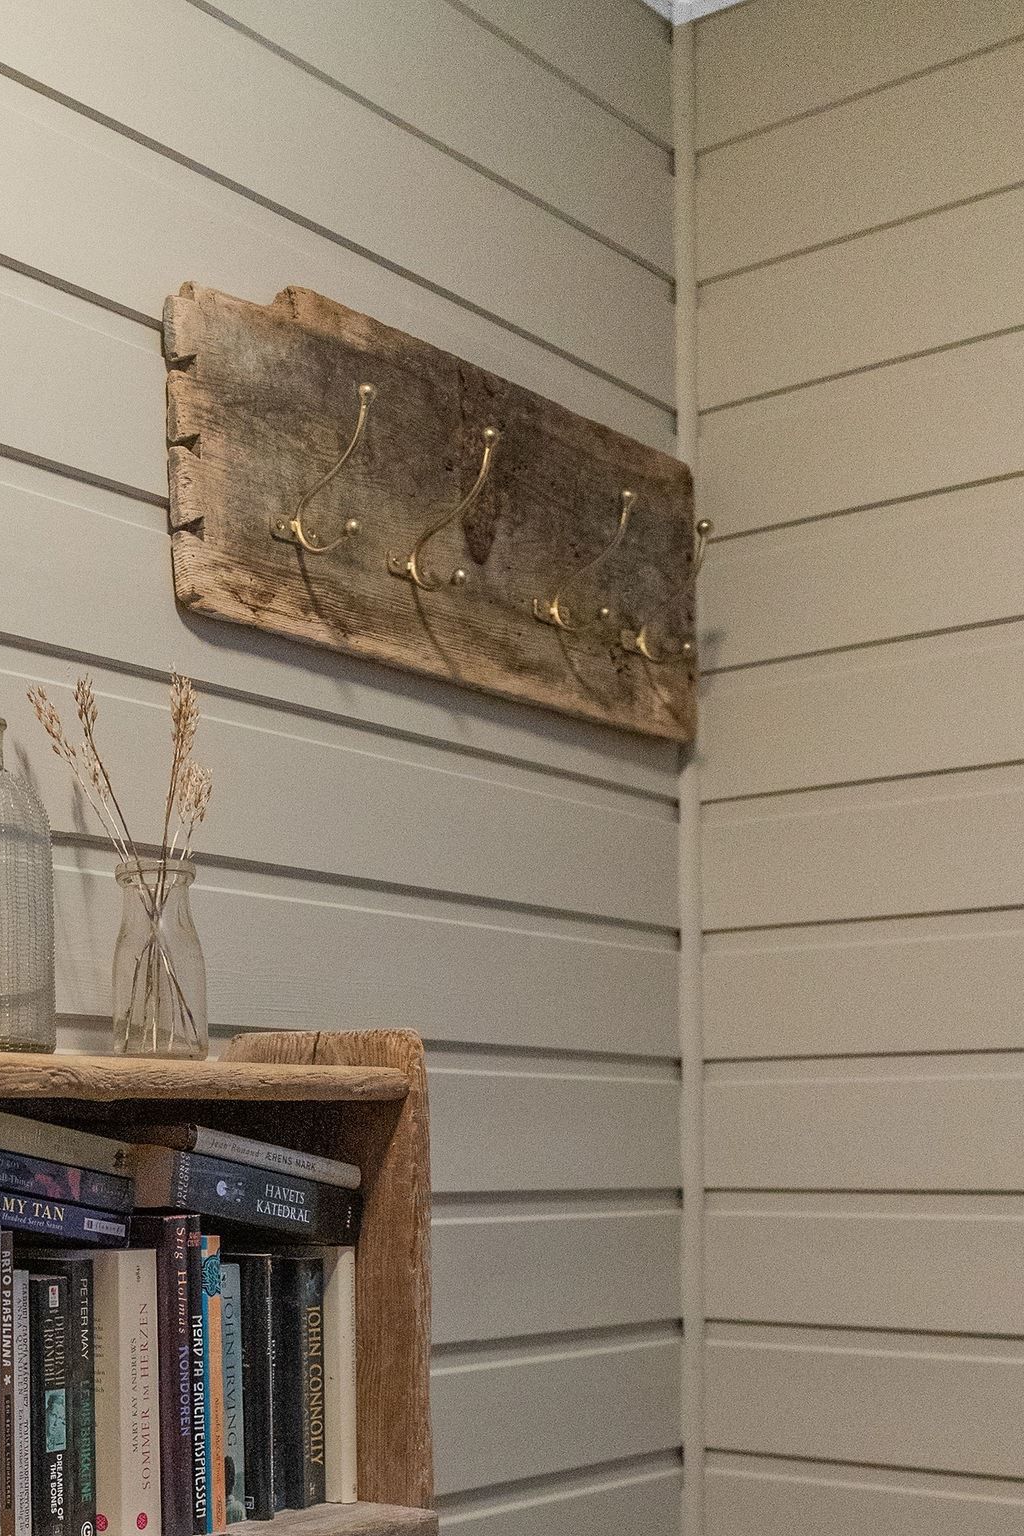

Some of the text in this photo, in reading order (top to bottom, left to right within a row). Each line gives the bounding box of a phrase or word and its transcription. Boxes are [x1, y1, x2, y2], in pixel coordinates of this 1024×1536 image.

[265, 1184, 305, 1205] HAVETS
[295, 1158, 316, 1171] MARK
[32, 1202, 65, 1222] TAN
[174, 1226, 187, 1260] Stig
[256, 1199, 310, 1224] KATEDRAL
[2, 1250, 13, 1368] ARTO PAASILINNA
[80, 1278, 90, 1361] PETER MAY
[137, 1302, 150, 1378] HERZEN
[16, 1335, 24, 1396] QUINDLEN
[130, 1336, 138, 1392] ANDREWS
[178, 1345, 192, 1437] KONDOREN
[223, 1295, 239, 1448] JOHN IRVING
[307, 1305, 324, 1466] JOHN CONNOLLY
[138, 1408, 152, 1491] SOMMER
[50, 1482, 58, 1515] BONES
[55, 1453, 64, 1522] DREAMING OF
